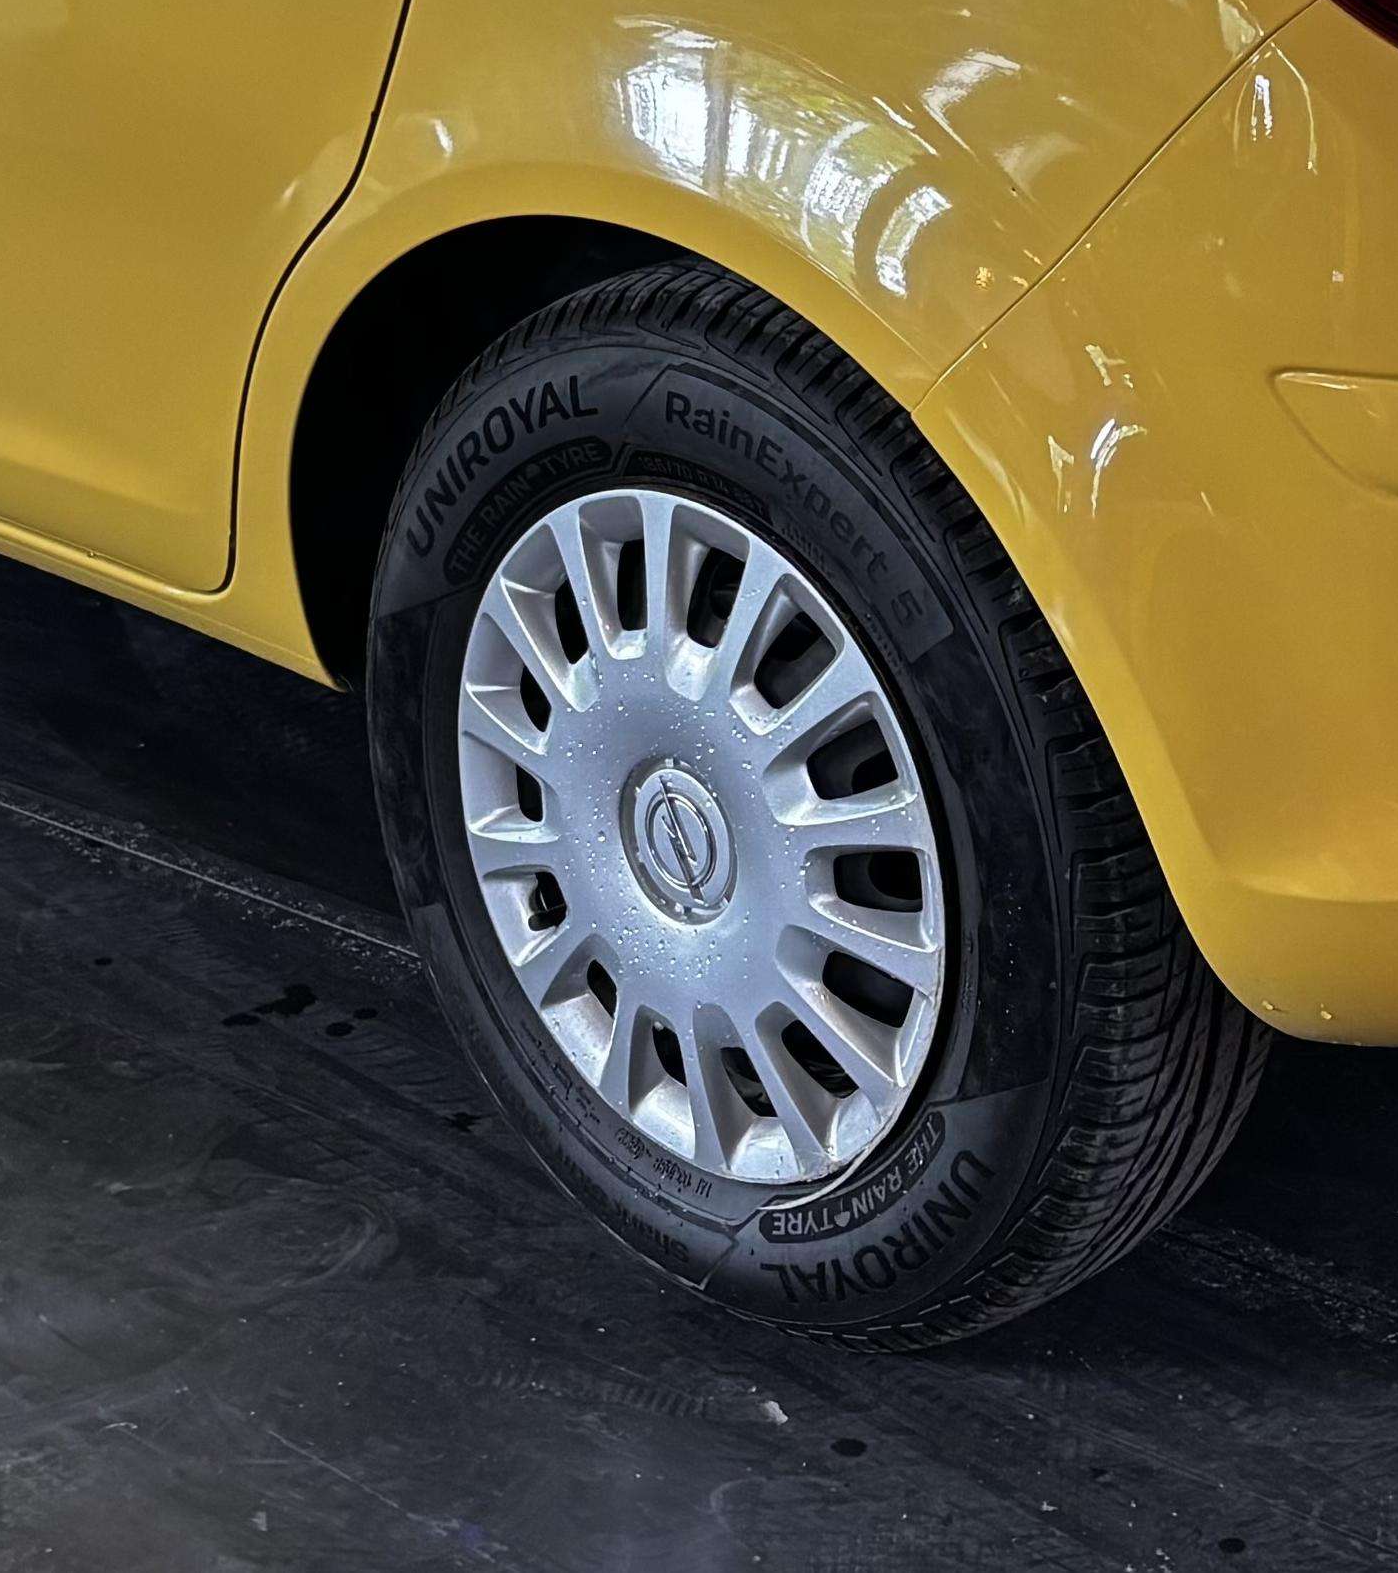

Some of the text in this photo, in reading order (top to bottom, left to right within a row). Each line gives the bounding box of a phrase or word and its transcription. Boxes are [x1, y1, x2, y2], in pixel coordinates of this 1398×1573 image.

[406, 375, 598, 558] UNIROYAL
[450, 443, 603, 573] THE RAIN TYRE
[666, 391, 889, 582] RainExpert
[760, 1150, 995, 1304] UNIROYAL
[772, 1119, 940, 1235] THE RAIN TYRE
